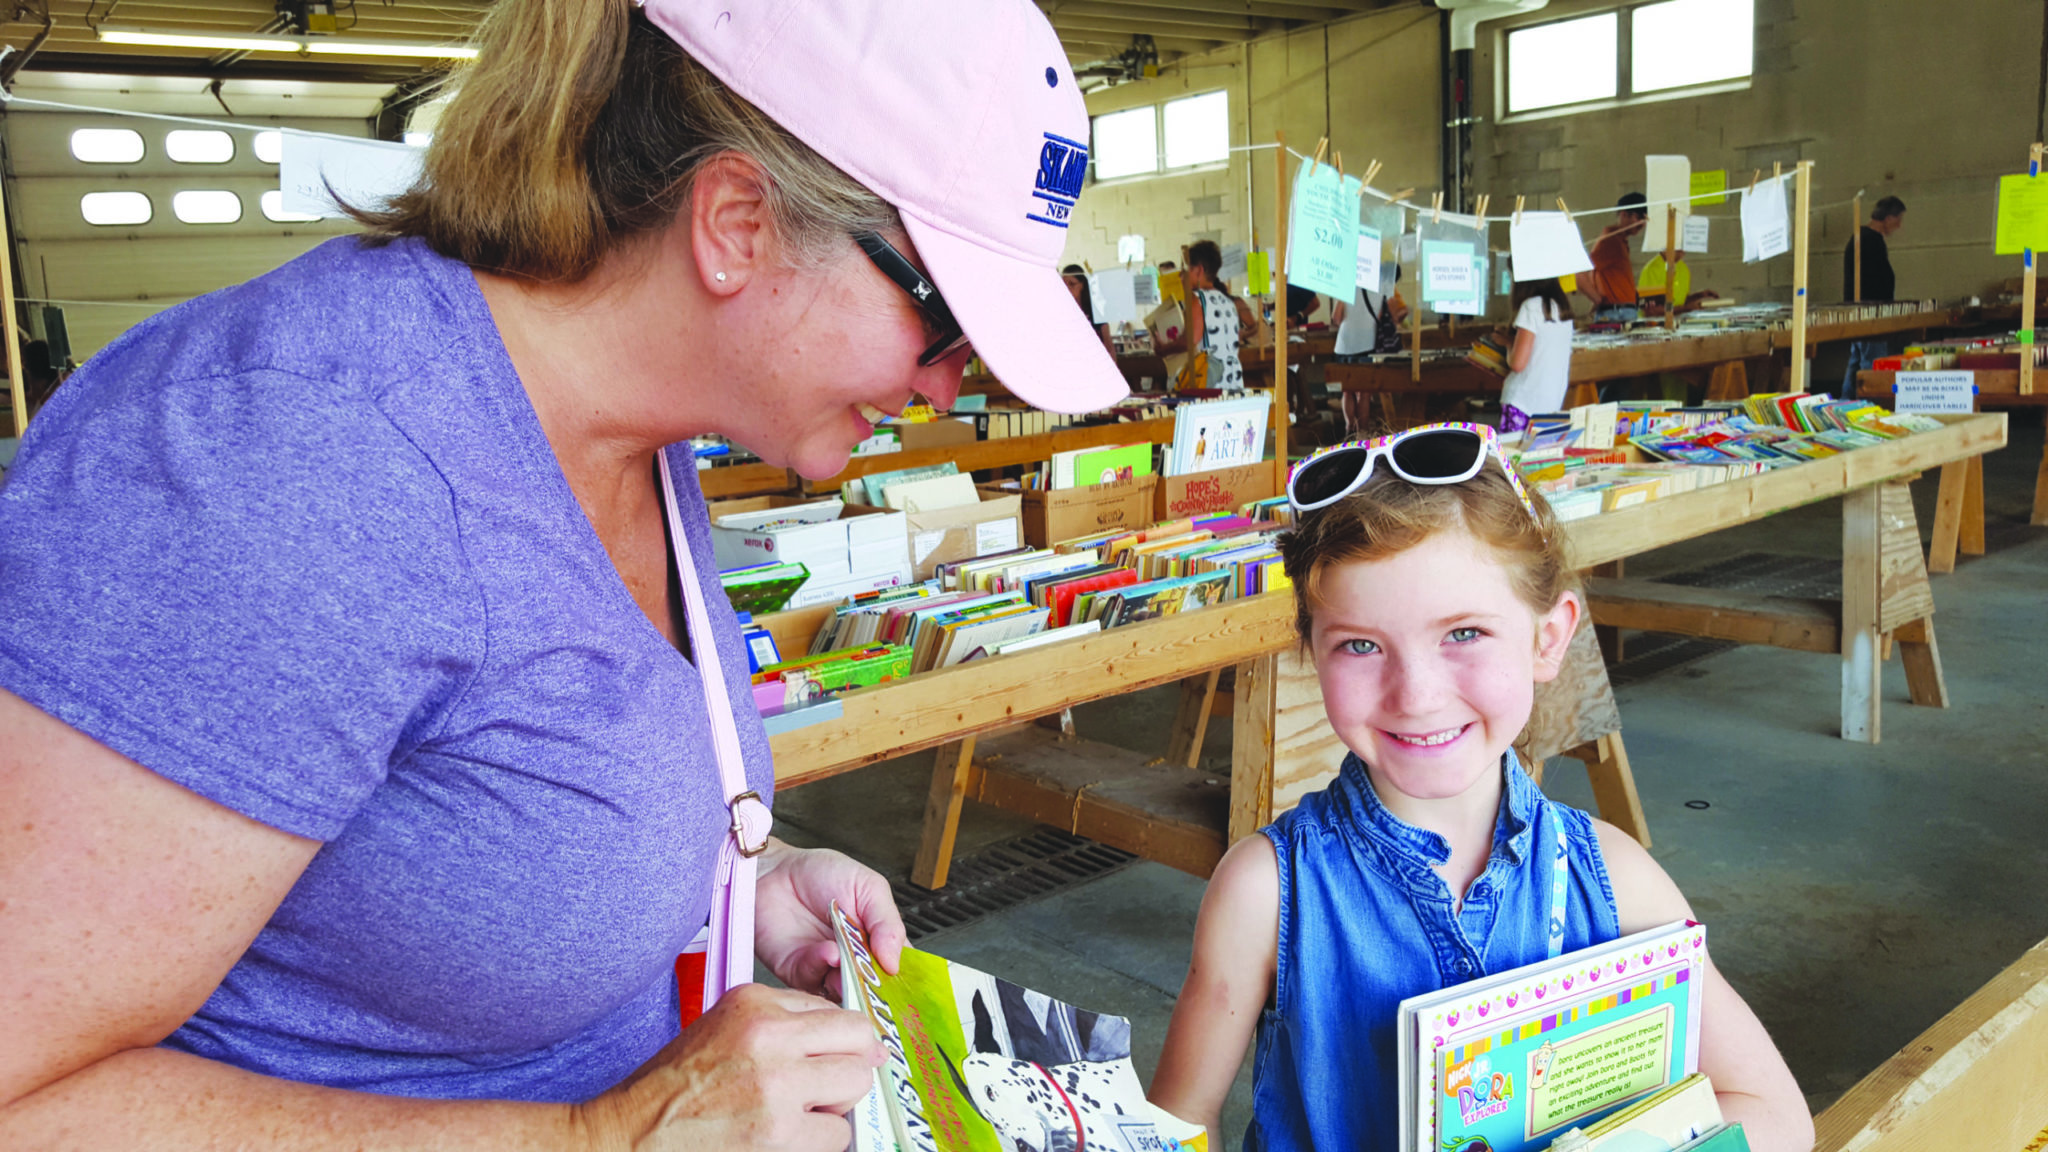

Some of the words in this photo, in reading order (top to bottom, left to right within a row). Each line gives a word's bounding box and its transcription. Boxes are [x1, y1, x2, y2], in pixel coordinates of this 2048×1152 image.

[1046, 202, 1070, 219] NEW
[1313, 226, 1344, 249] $2.00
[1210, 438, 1241, 461] ART
[1185, 475, 1220, 500] HOPE'S
[744, 538, 763, 548] xerox
[838, 908, 881, 988] OUT
[863, 978, 913, 1079] DAY
[1559, 1056, 1573, 1065] Dora
[1575, 1044, 1602, 1059] uncovers
[1604, 1040, 1612, 1048] an
[1613, 1032, 1636, 1045] ancient
[1639, 1022, 1663, 1036] treasure
[1448, 1060, 1472, 1090] NICK
[1550, 1071, 1561, 1080] and
[1564, 1066, 1574, 1075] she
[1576, 1059, 1594, 1070] wants
[1604, 1051, 1619, 1060] show
[1636, 1040, 1646, 1048] her
[1550, 1083, 1564, 1093] right
[1566, 1075, 1584, 1086] away!
[1586, 1070, 1598, 1079] Join
[1600, 1064, 1615, 1074] Dora
[1616, 1059, 1627, 1068] and
[1629, 1053, 1645, 1064] Boots
[1458, 1073, 1513, 1117] DORA
[1559, 1088, 1583, 1102] exciting
[1585, 1075, 1616, 1092] adventure
[1618, 1069, 1629, 1079] and
[1631, 1065, 1642, 1073] find
[1644, 1061, 1654, 1070] out
[1464, 1101, 1507, 1125] EXPLORER
[1548, 1108, 1563, 1118] what
[1565, 1103, 1575, 1112] the
[1577, 1092, 1603, 1107] treasure
[1605, 1085, 1622, 1097] really
